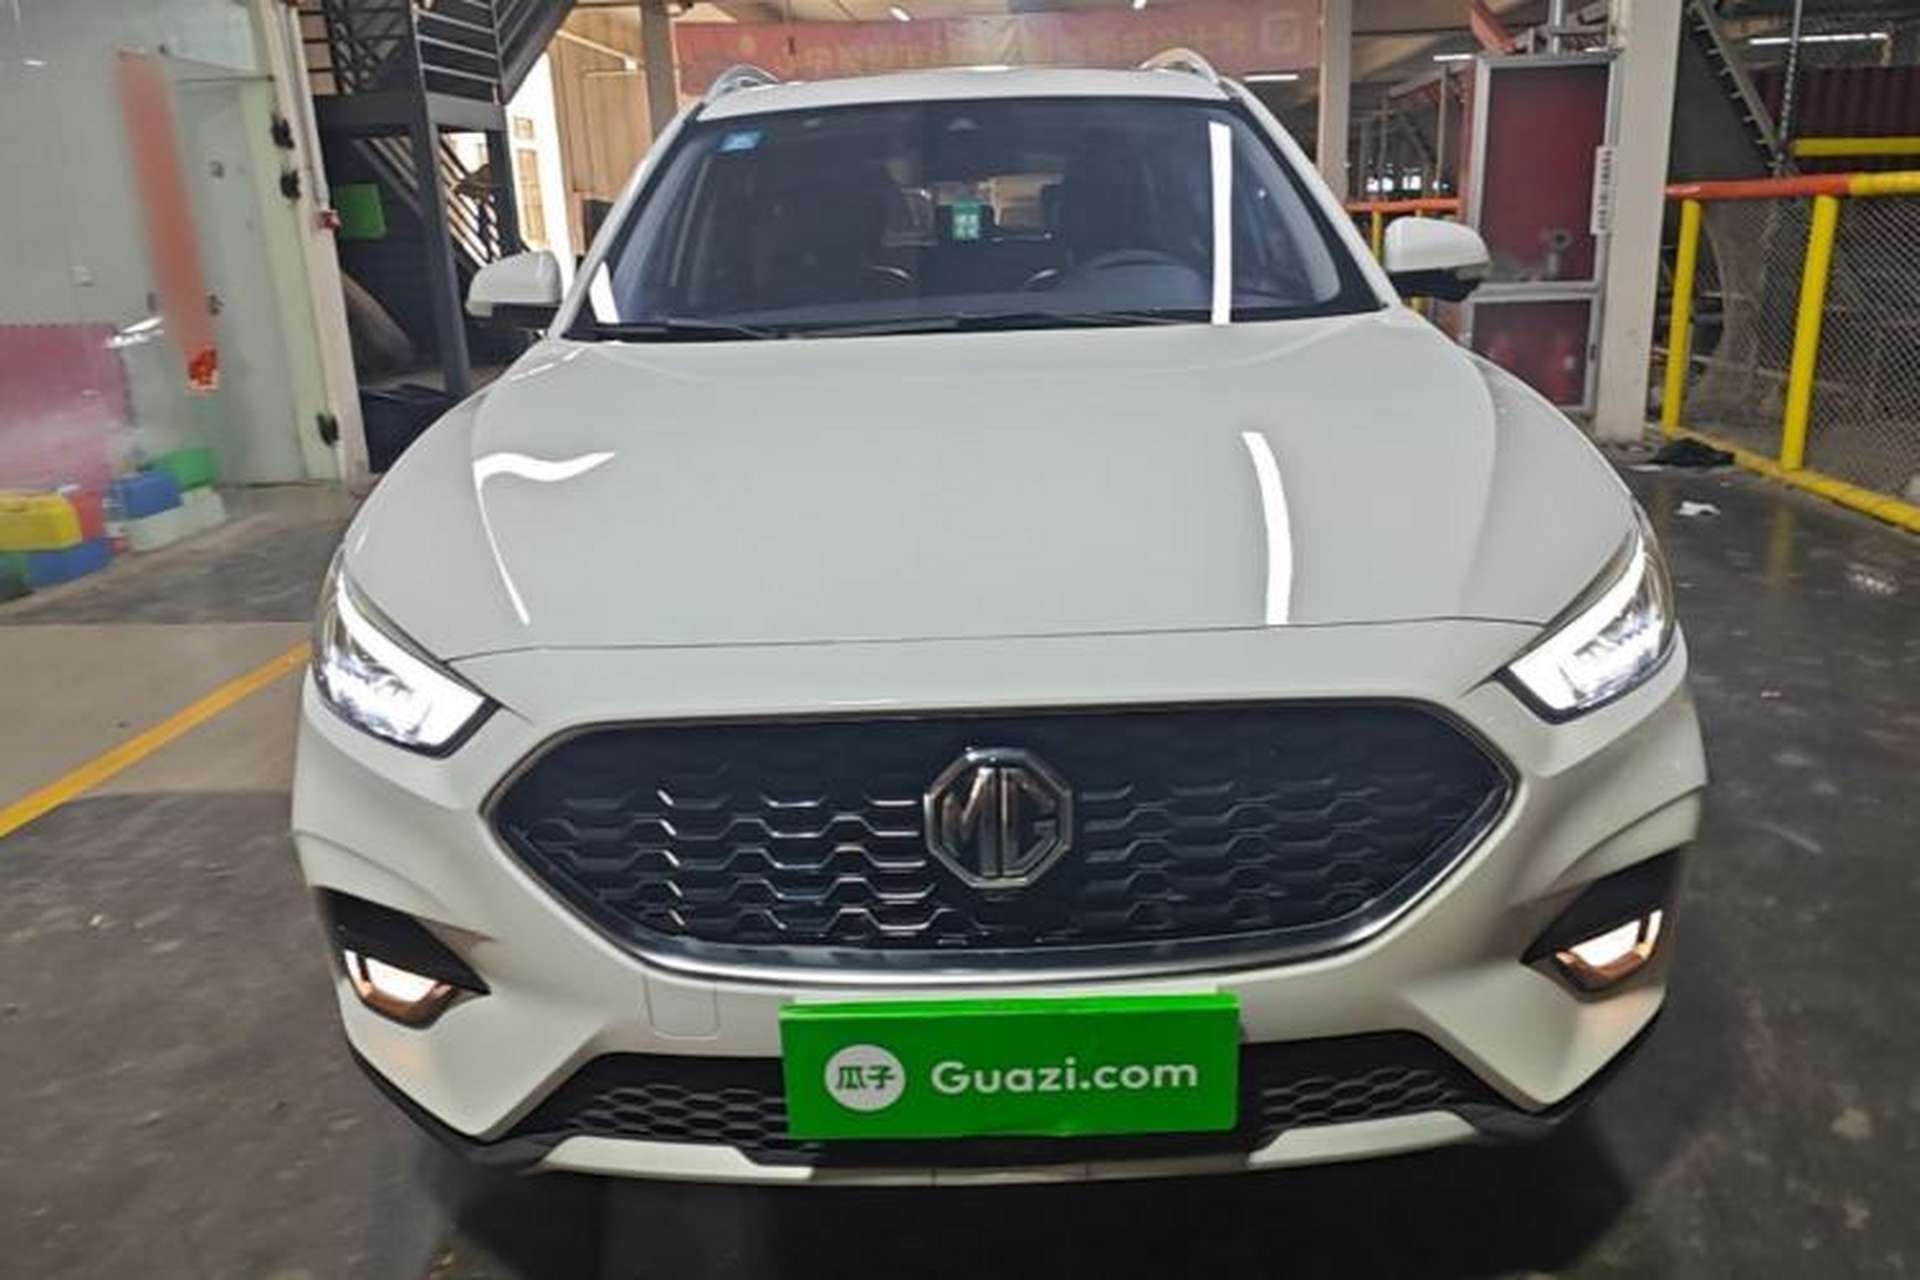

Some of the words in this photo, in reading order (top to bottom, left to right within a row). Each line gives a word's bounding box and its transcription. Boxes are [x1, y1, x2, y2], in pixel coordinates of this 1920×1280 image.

[941, 766, 1057, 877] MG
[836, 1064, 897, 1090] 瓜子
[931, 1056, 1199, 1094] Guazi.com
